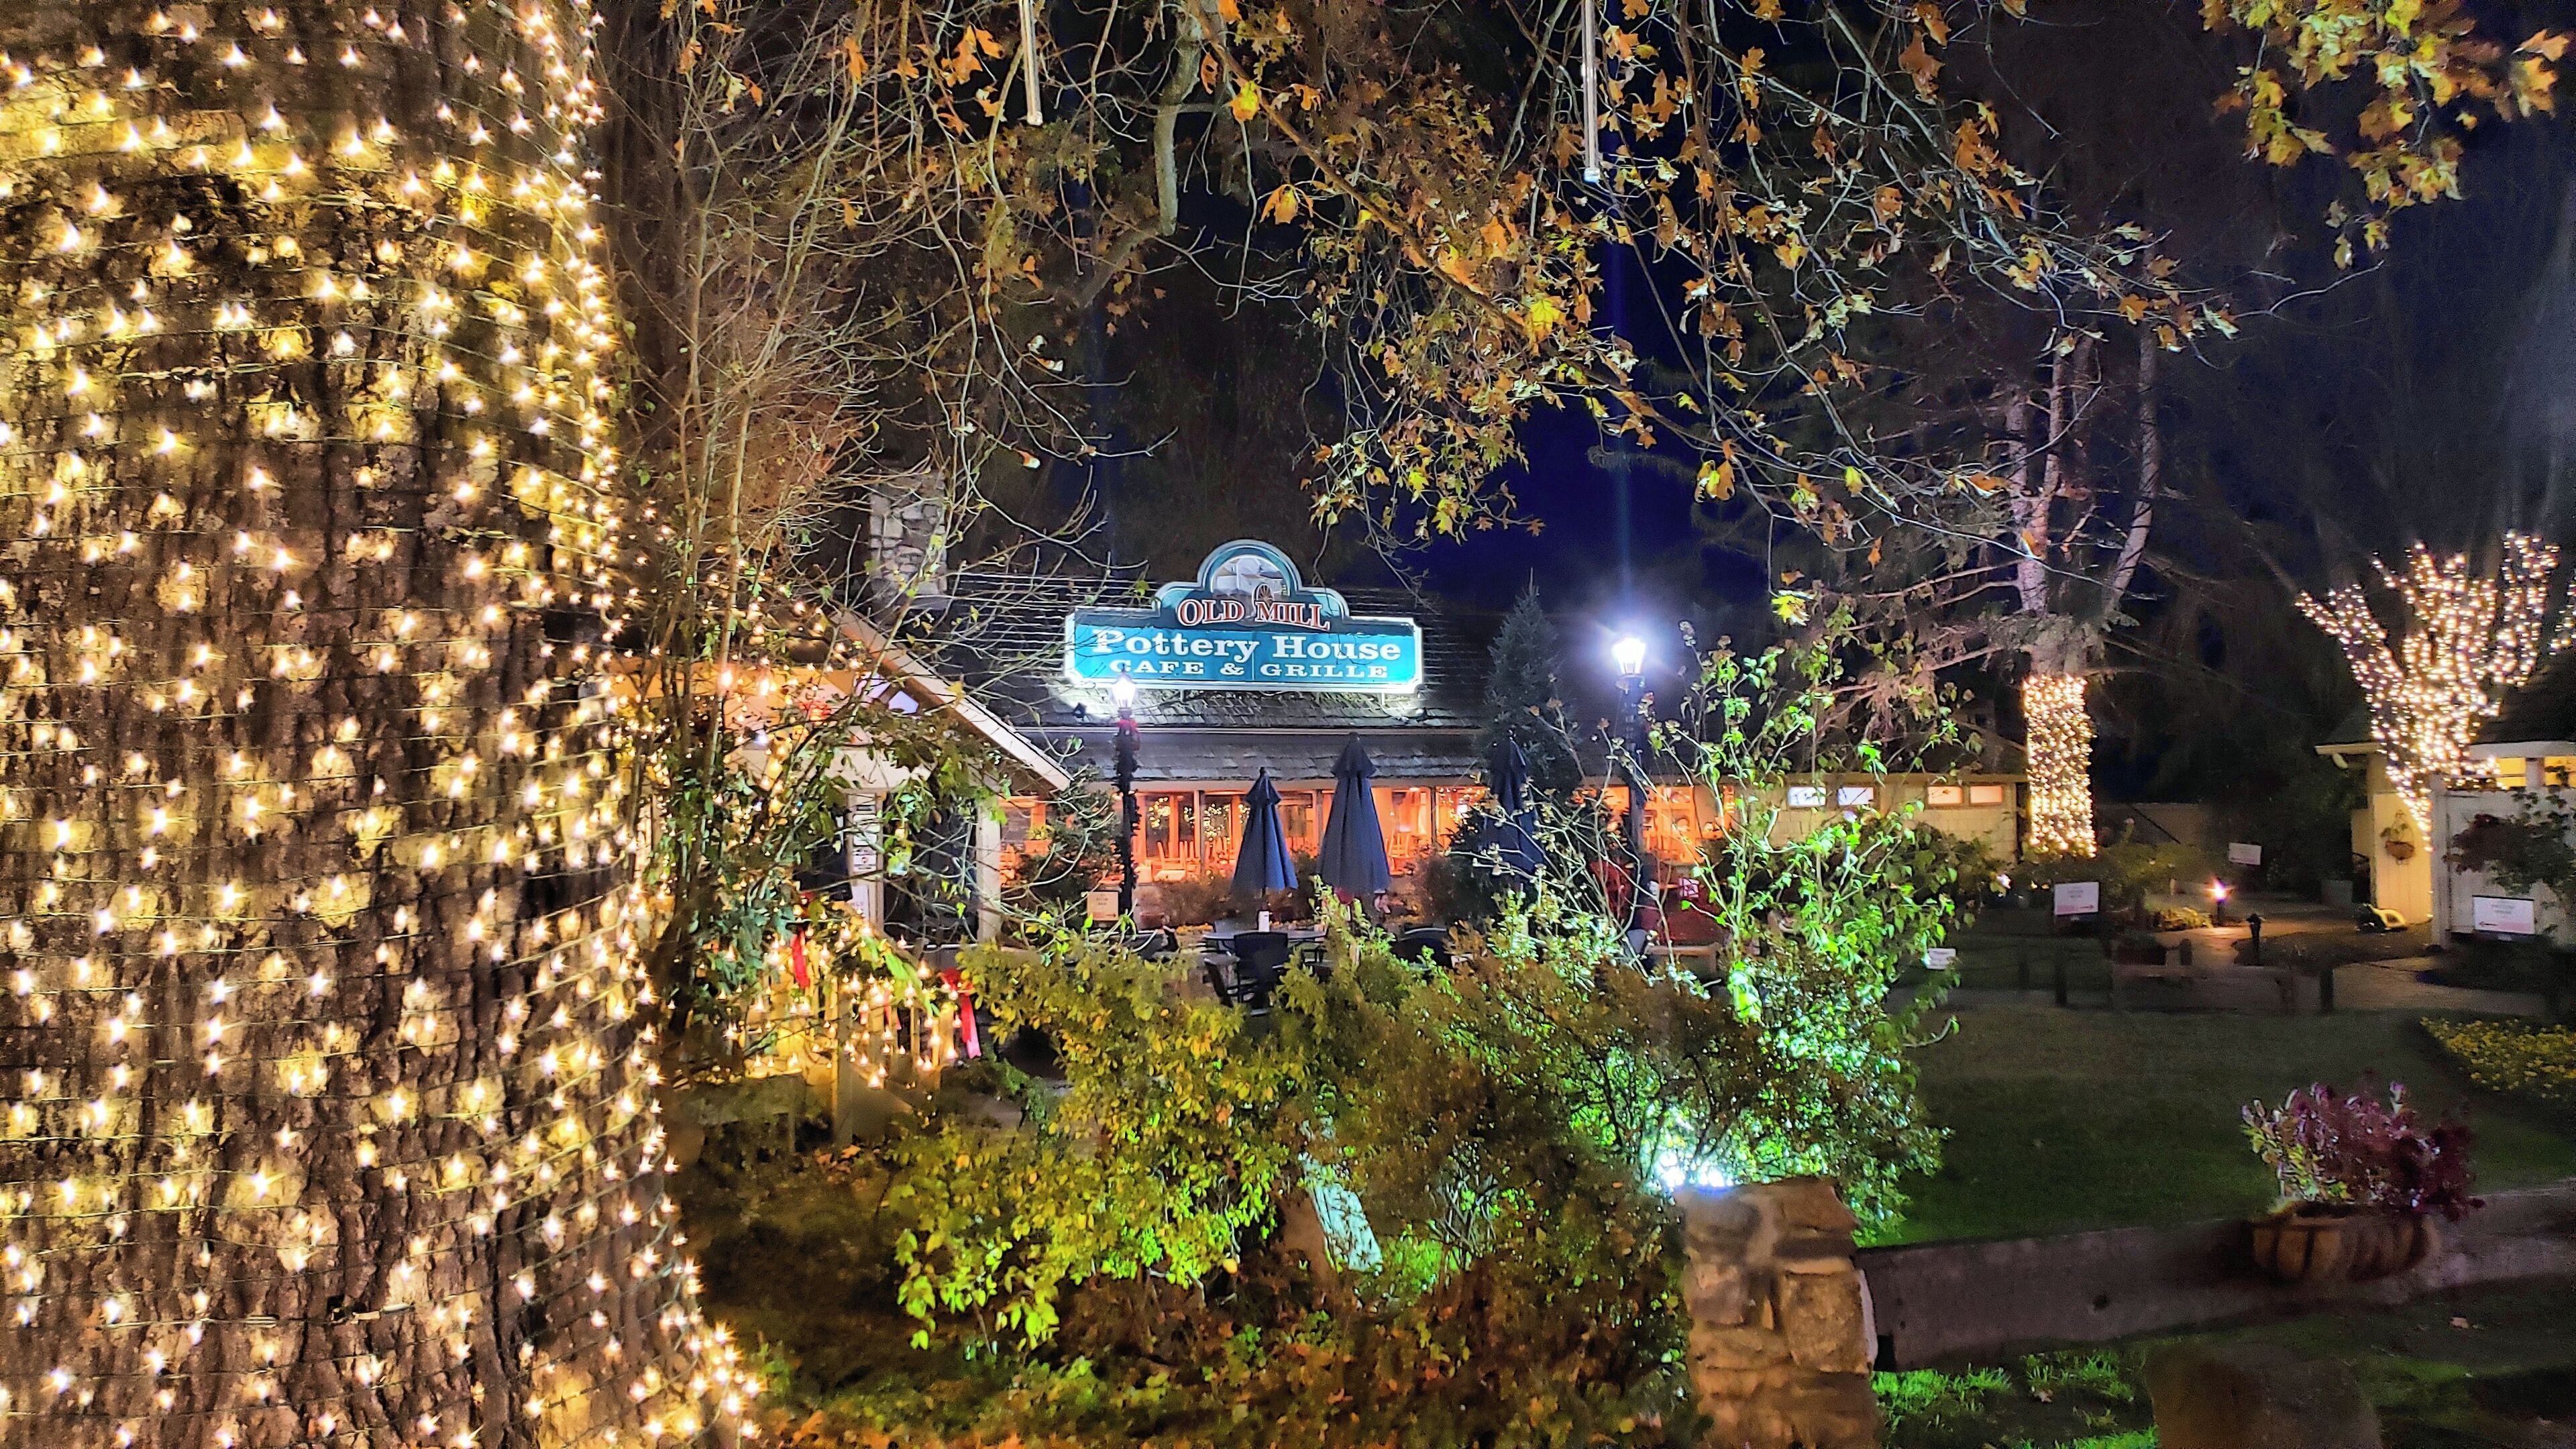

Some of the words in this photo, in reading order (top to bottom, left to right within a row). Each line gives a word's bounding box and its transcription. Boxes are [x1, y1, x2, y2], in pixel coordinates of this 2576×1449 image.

[1177, 599, 1245, 626] OLD
[1254, 601, 1331, 631] MILL
[1091, 629, 1260, 663] Pottery
[1272, 636, 1401, 660] House
[1110, 659, 1204, 675] CAFE
[1220, 662, 1244, 676] &
[1260, 663, 1389, 678] GRILLE
